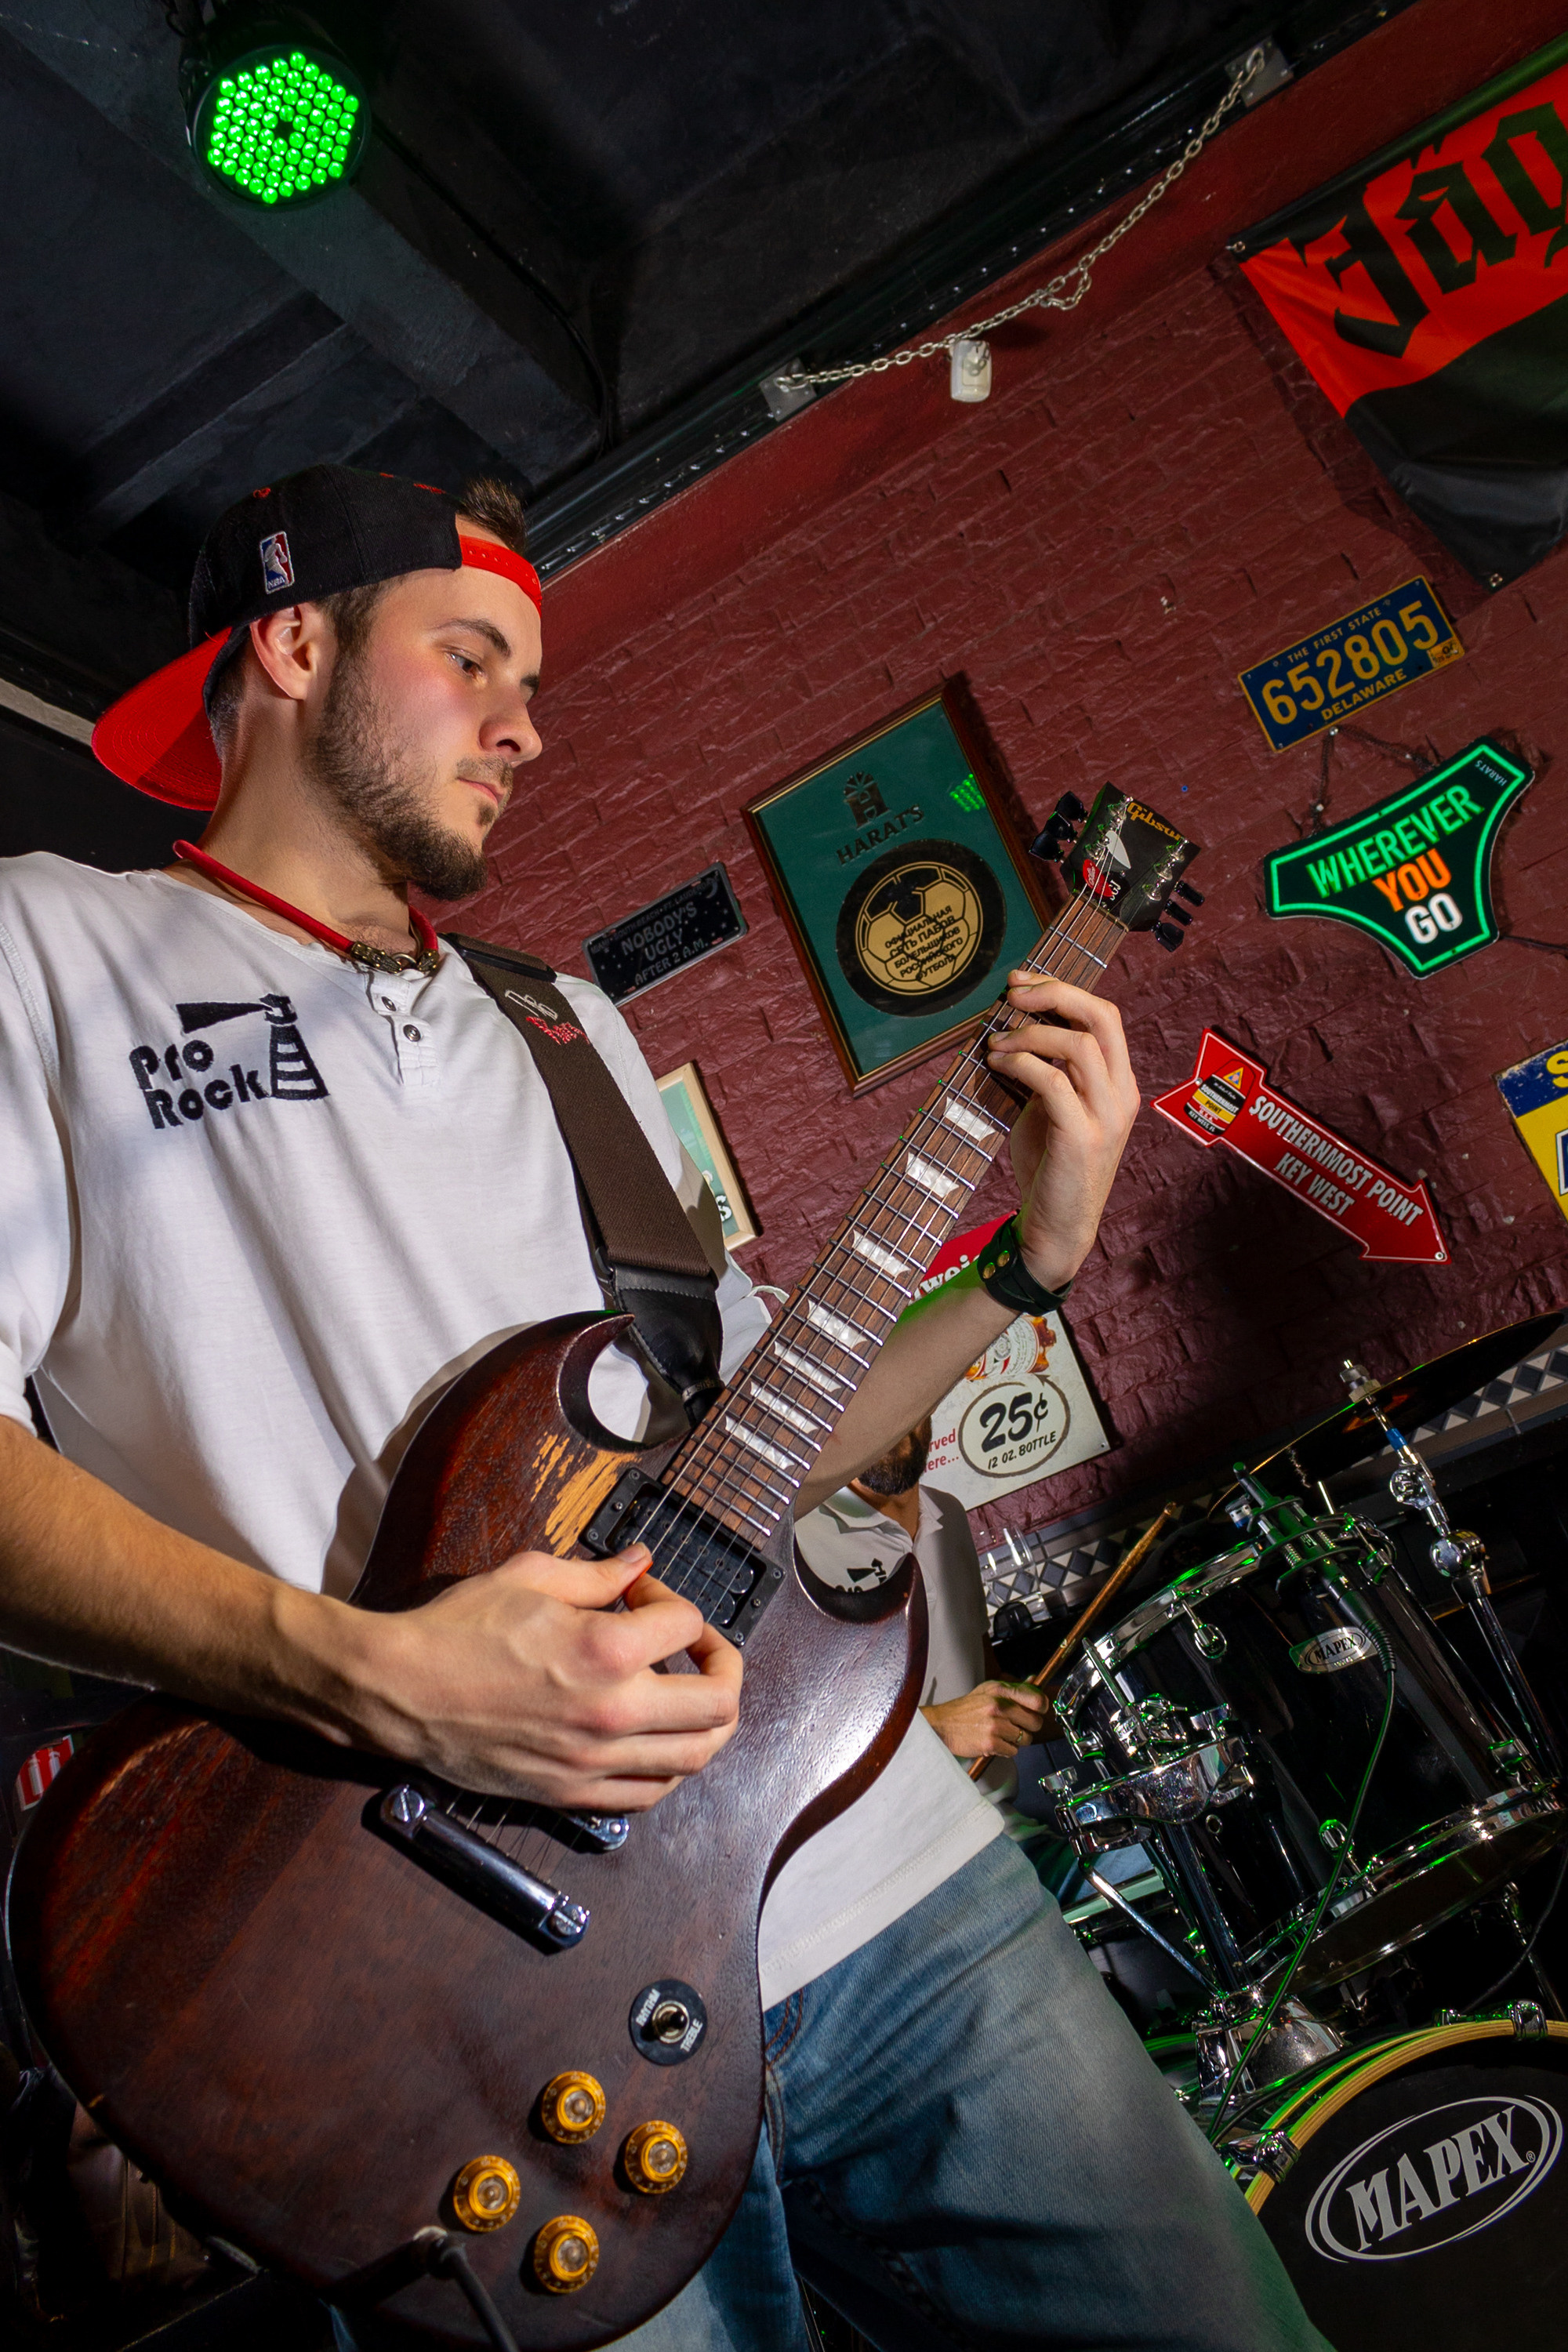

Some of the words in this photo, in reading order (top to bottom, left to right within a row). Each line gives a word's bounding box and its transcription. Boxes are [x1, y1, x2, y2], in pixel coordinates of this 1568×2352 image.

[1287, 648, 1309, 664] THE
[1313, 629, 1344, 650] FIRST
[1348, 607, 1382, 631] STATE
[1262, 601, 1439, 724] 652805
[1321, 668, 1407, 720] DELAWARE
[1127, 801, 1182, 841] Gibson
[1305, 785, 1485, 899] WHEREVER
[1372, 848, 1452, 913] YOU
[620, 901, 698, 956] NOBODY'S
[644, 928, 684, 961] UGLY
[917, 915, 956, 943] ПАБОВ
[1404, 892, 1463, 945] GO
[634, 957, 672, 986] AFTER
[673, 952, 681, 964] 2
[1204, 1100, 1222, 1114] POINT
[1248, 1095, 1374, 1191] SOUTHERNMOST
[1365, 1180, 1425, 1227] POINT
[1273, 1152, 1312, 1185] KEY
[1305, 1174, 1356, 1218] WEST
[988, 1455, 999, 1470] 12
[1018, 1430, 1057, 1457] BOTTLE
[1314, 1634, 1357, 1661] MAPEX
[1345, 2105, 1529, 2252] MAPEX
